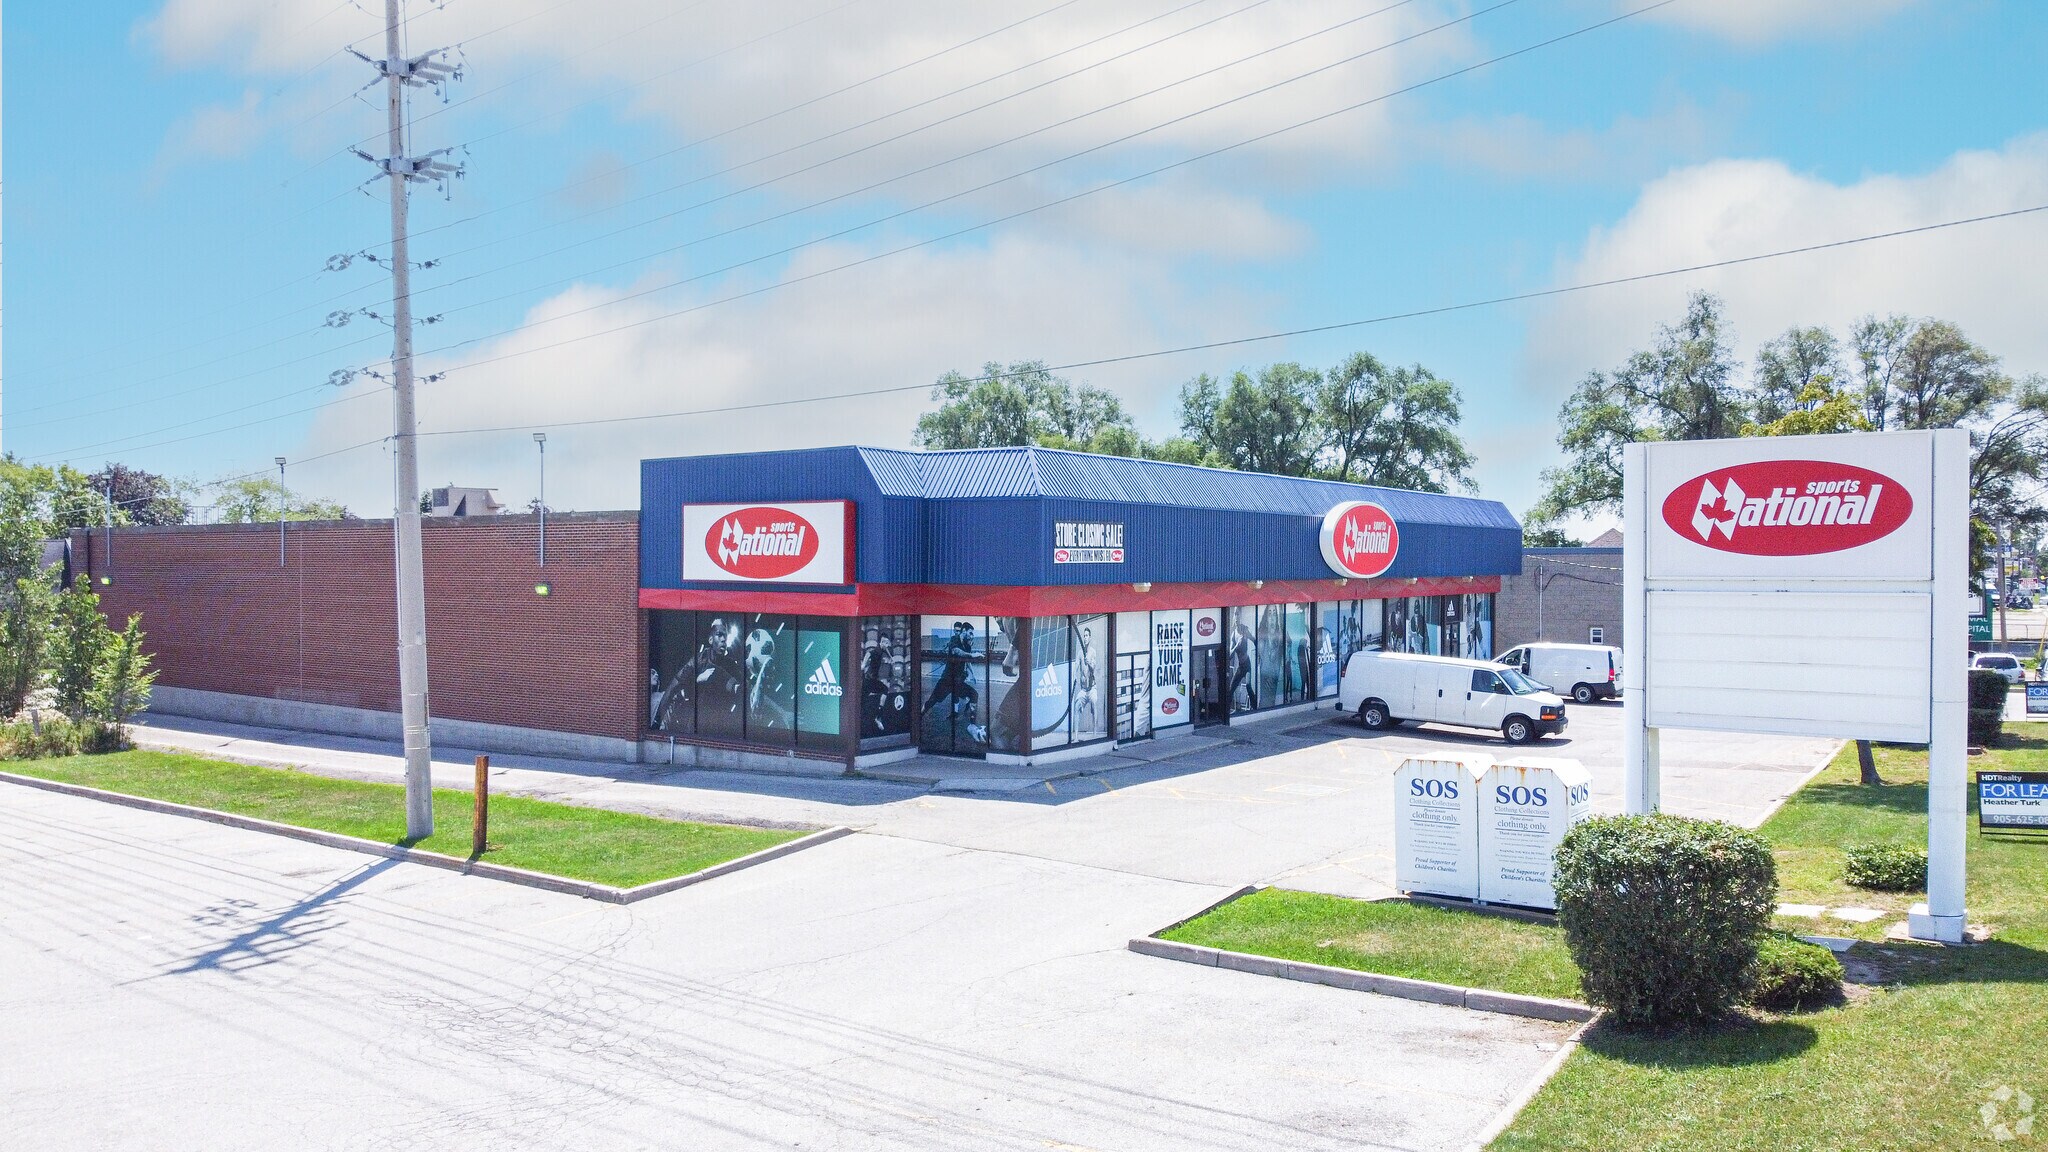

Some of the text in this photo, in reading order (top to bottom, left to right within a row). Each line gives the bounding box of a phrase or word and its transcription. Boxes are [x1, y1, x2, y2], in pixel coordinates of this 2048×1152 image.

[1806, 479, 1861, 495] sports
[1692, 477, 1883, 541] National
[770, 522, 796, 532] sports
[1055, 522, 1077, 547] STORE
[1078, 523, 1104, 547] CLOSING
[718, 518, 806, 566] National
[1157, 622, 1184, 644] RAISE
[1158, 644, 1183, 665] YOUR
[805, 681, 842, 696] adidas
[1035, 684, 1062, 697] adidas
[1411, 778, 1458, 799] SOS
[1496, 785, 1548, 806] SOS
[1571, 782, 1588, 806] SOS
[1982, 784, 2018, 797] FOR
[1412, 811, 1457, 822] clothing only
[1494, 806, 1518, 814] Clothing
[1498, 820, 1546, 831] clothing only
